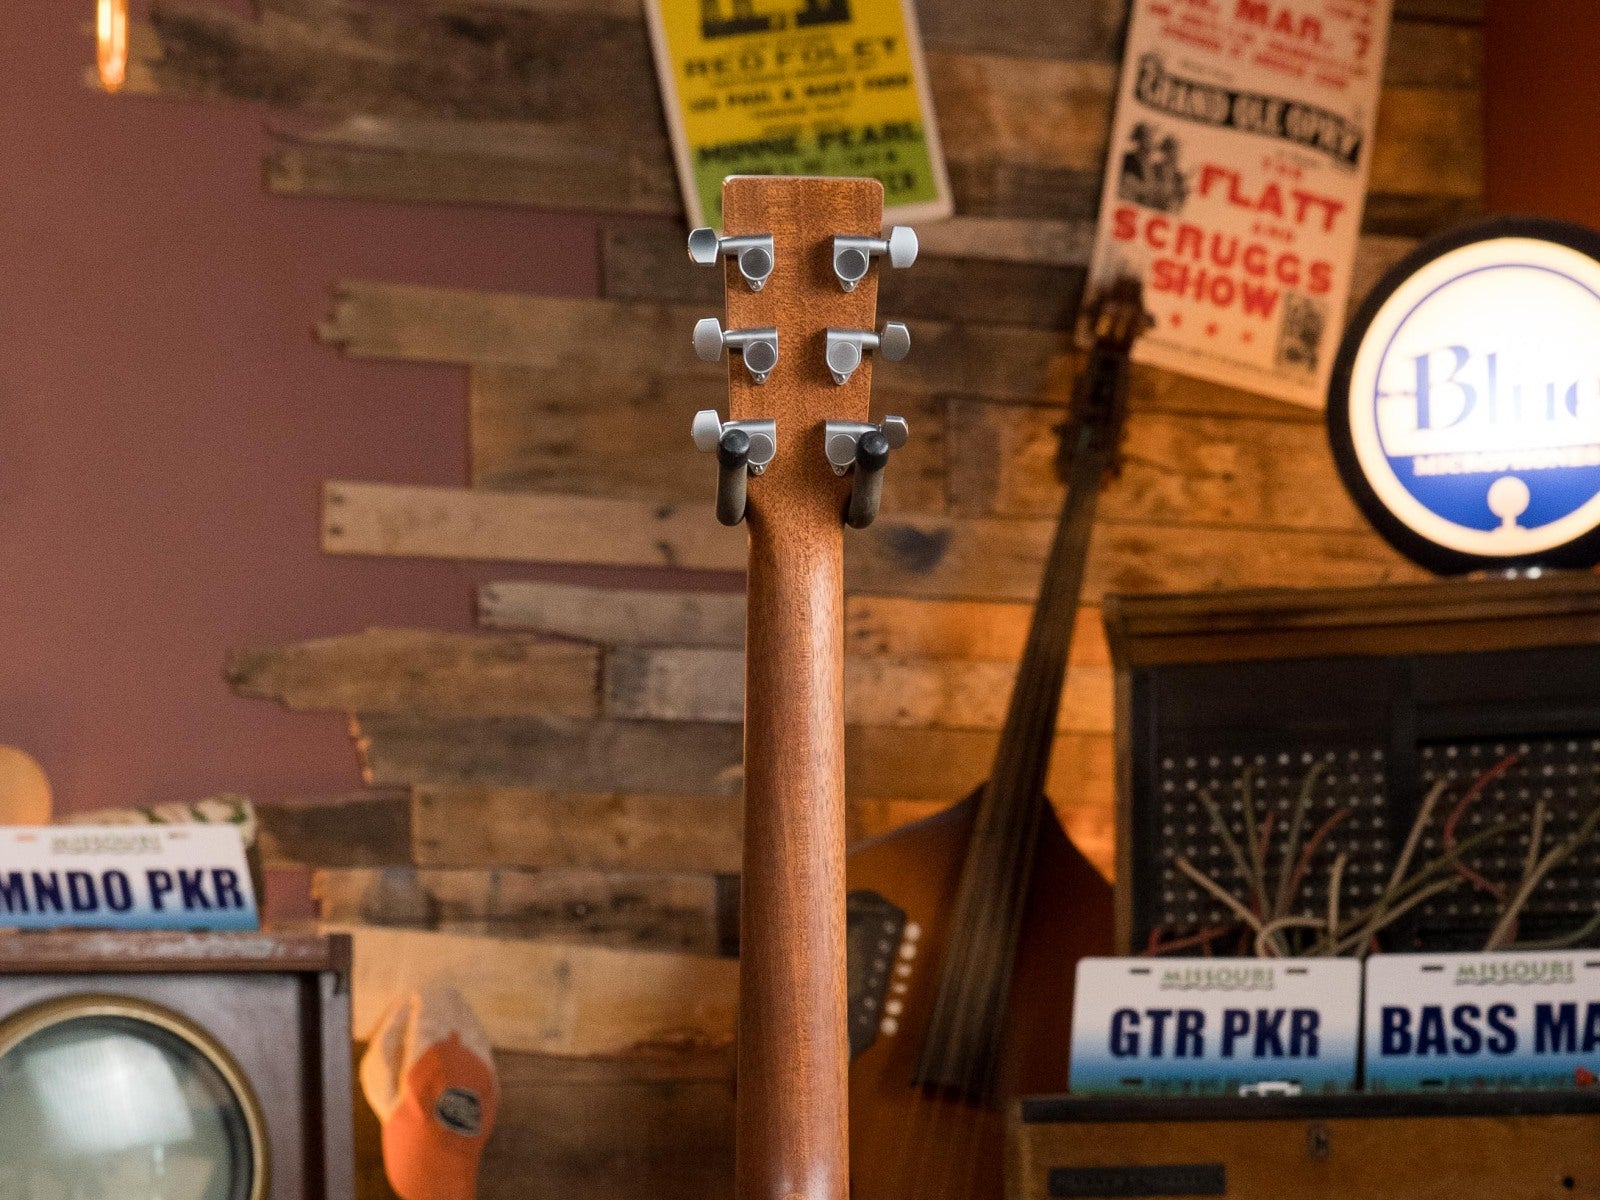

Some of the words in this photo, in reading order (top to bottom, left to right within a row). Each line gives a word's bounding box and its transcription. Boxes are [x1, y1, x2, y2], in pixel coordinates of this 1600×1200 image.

[1233, 94, 1280, 136] OLE
[1200, 162, 1344, 233] FLATT
[1112, 206, 1333, 296] SCRUGGS
[1152, 258, 1279, 321] SHOW
[0, 868, 134, 914] MNDO
[146, 868, 246, 912] PKR
[1162, 966, 1274, 983] MISSOURI
[1457, 960, 1574, 979] MISSOURI
[1109, 1007, 1206, 1059] GTR
[1219, 1007, 1321, 1059] PKR
[1380, 1002, 1518, 1056] BASS
